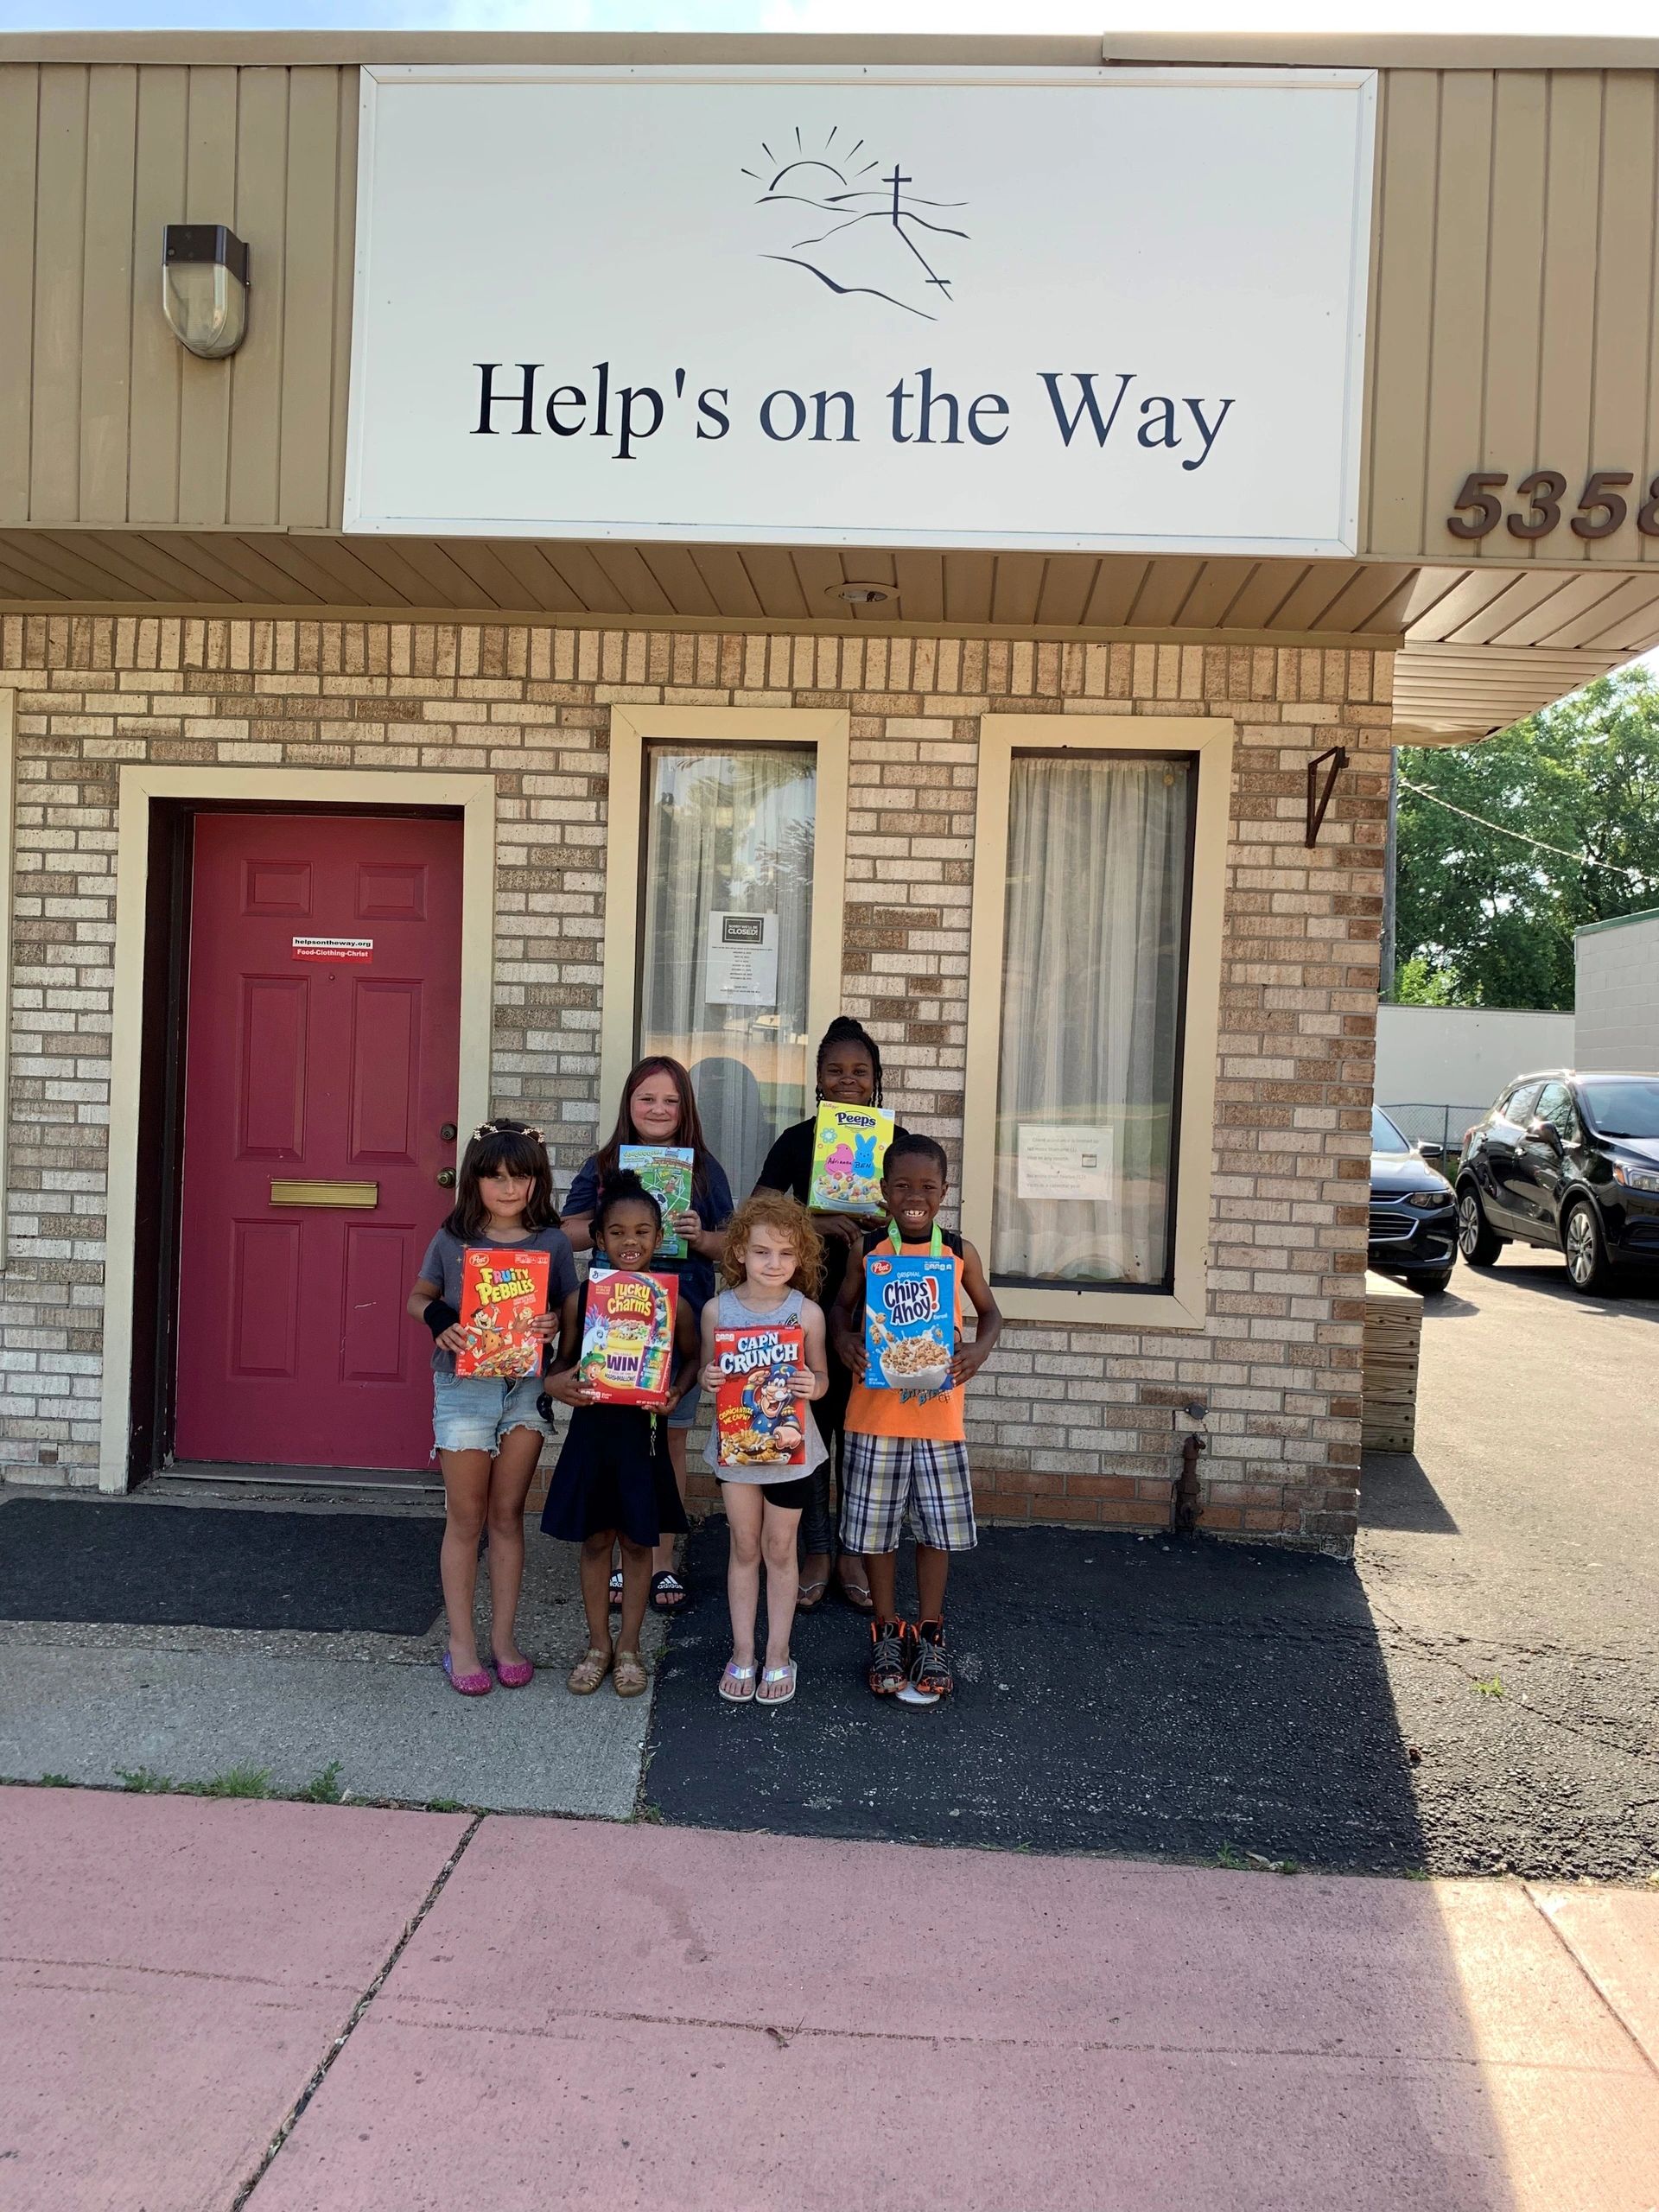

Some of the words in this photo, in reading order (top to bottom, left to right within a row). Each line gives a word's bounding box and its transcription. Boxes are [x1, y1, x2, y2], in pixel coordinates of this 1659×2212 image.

[469, 361, 730, 459] Help's
[760, 390, 861, 442] on
[886, 367, 1009, 446] the
[1036, 373, 1236, 471] Way
[295, 938, 372, 947] helpsontheway.org
[297, 949, 368, 958] Food-Clothing-Christ
[835, 1112, 876, 1126] Peeps
[472, 1255, 486, 1264] Post
[874, 1262, 889, 1273] Post
[614, 1283, 651, 1301] Lucky
[884, 1281, 928, 1308] Chips
[892, 1278, 939, 1323] Ahoy!
[607, 1297, 652, 1316] Charms
[737, 1332, 779, 1352] CAP'N
[607, 1354, 639, 1371] WIN
[720, 1343, 798, 1375] CRUNCH
